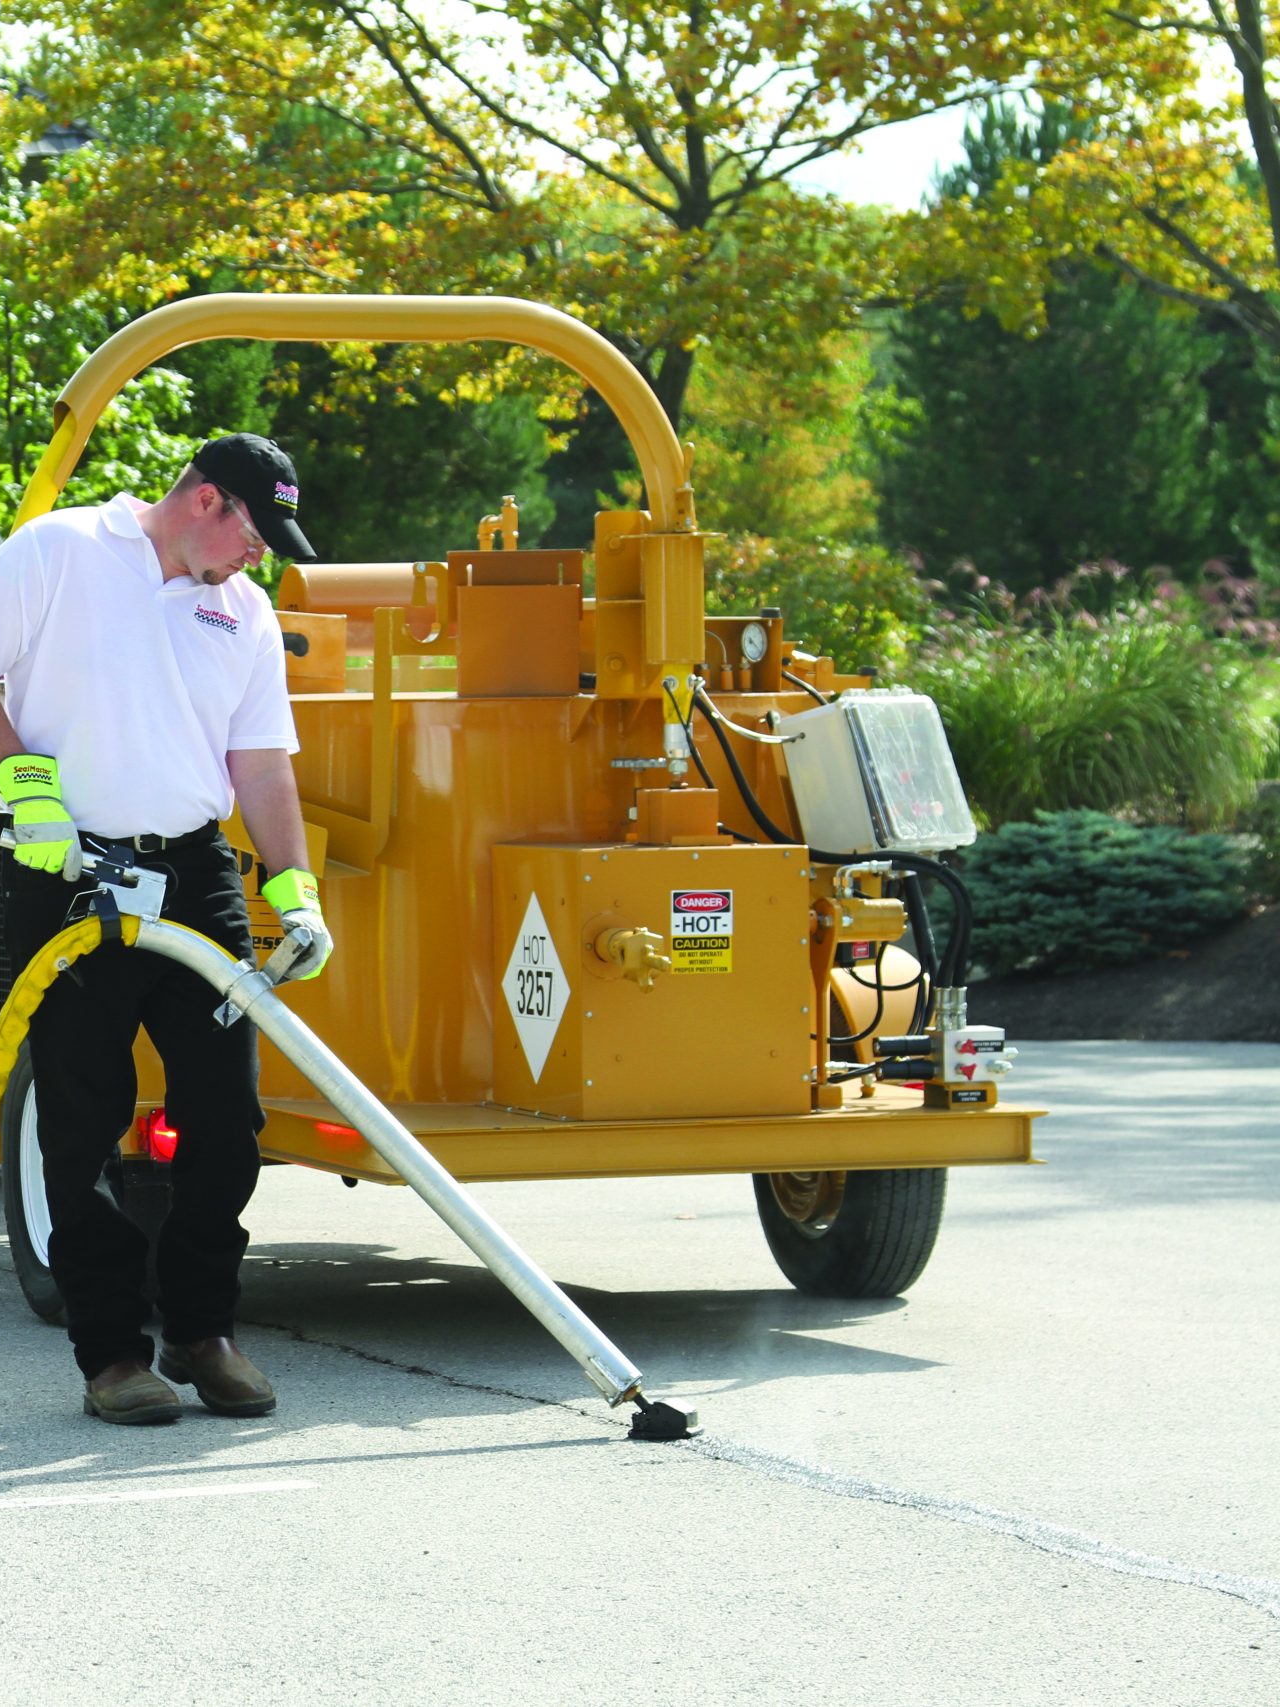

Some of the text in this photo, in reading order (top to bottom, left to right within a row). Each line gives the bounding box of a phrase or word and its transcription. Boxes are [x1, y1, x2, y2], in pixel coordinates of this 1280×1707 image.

[13, 765, 52, 775] SealMaster
[681, 898, 723, 907] DANGER
[675, 939, 728, 949] CAUTION
[523, 935, 546, 964] HOT
[517, 970, 553, 1017] 3257
